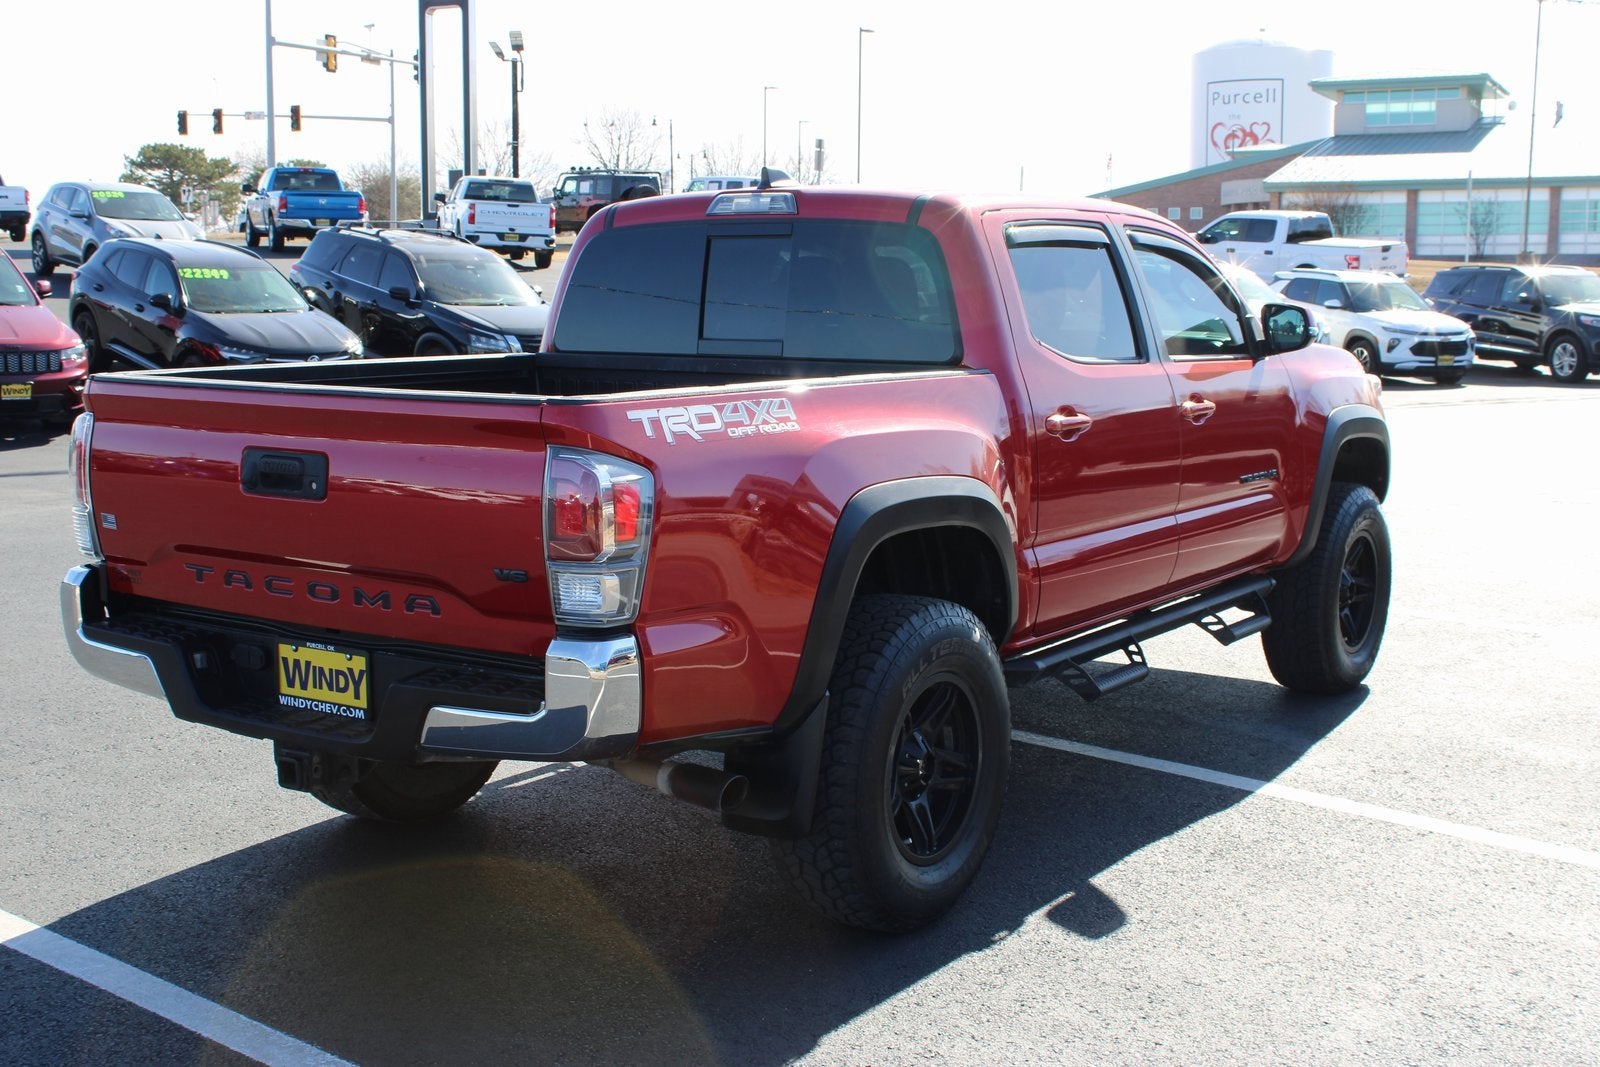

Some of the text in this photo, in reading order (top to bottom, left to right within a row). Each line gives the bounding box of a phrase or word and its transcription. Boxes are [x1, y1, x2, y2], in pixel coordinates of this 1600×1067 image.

[1212, 88, 1276, 106] Purcell
[480, 209, 545, 217] CHEVROLET
[626, 404, 725, 445] TRD
[727, 420, 801, 438] OFF ROAD
[493, 567, 529, 583] V6
[184, 562, 442, 617] TACOMA
[281, 656, 366, 700] WINDY
[278, 695, 365, 719] WINDYCHEV.COM
